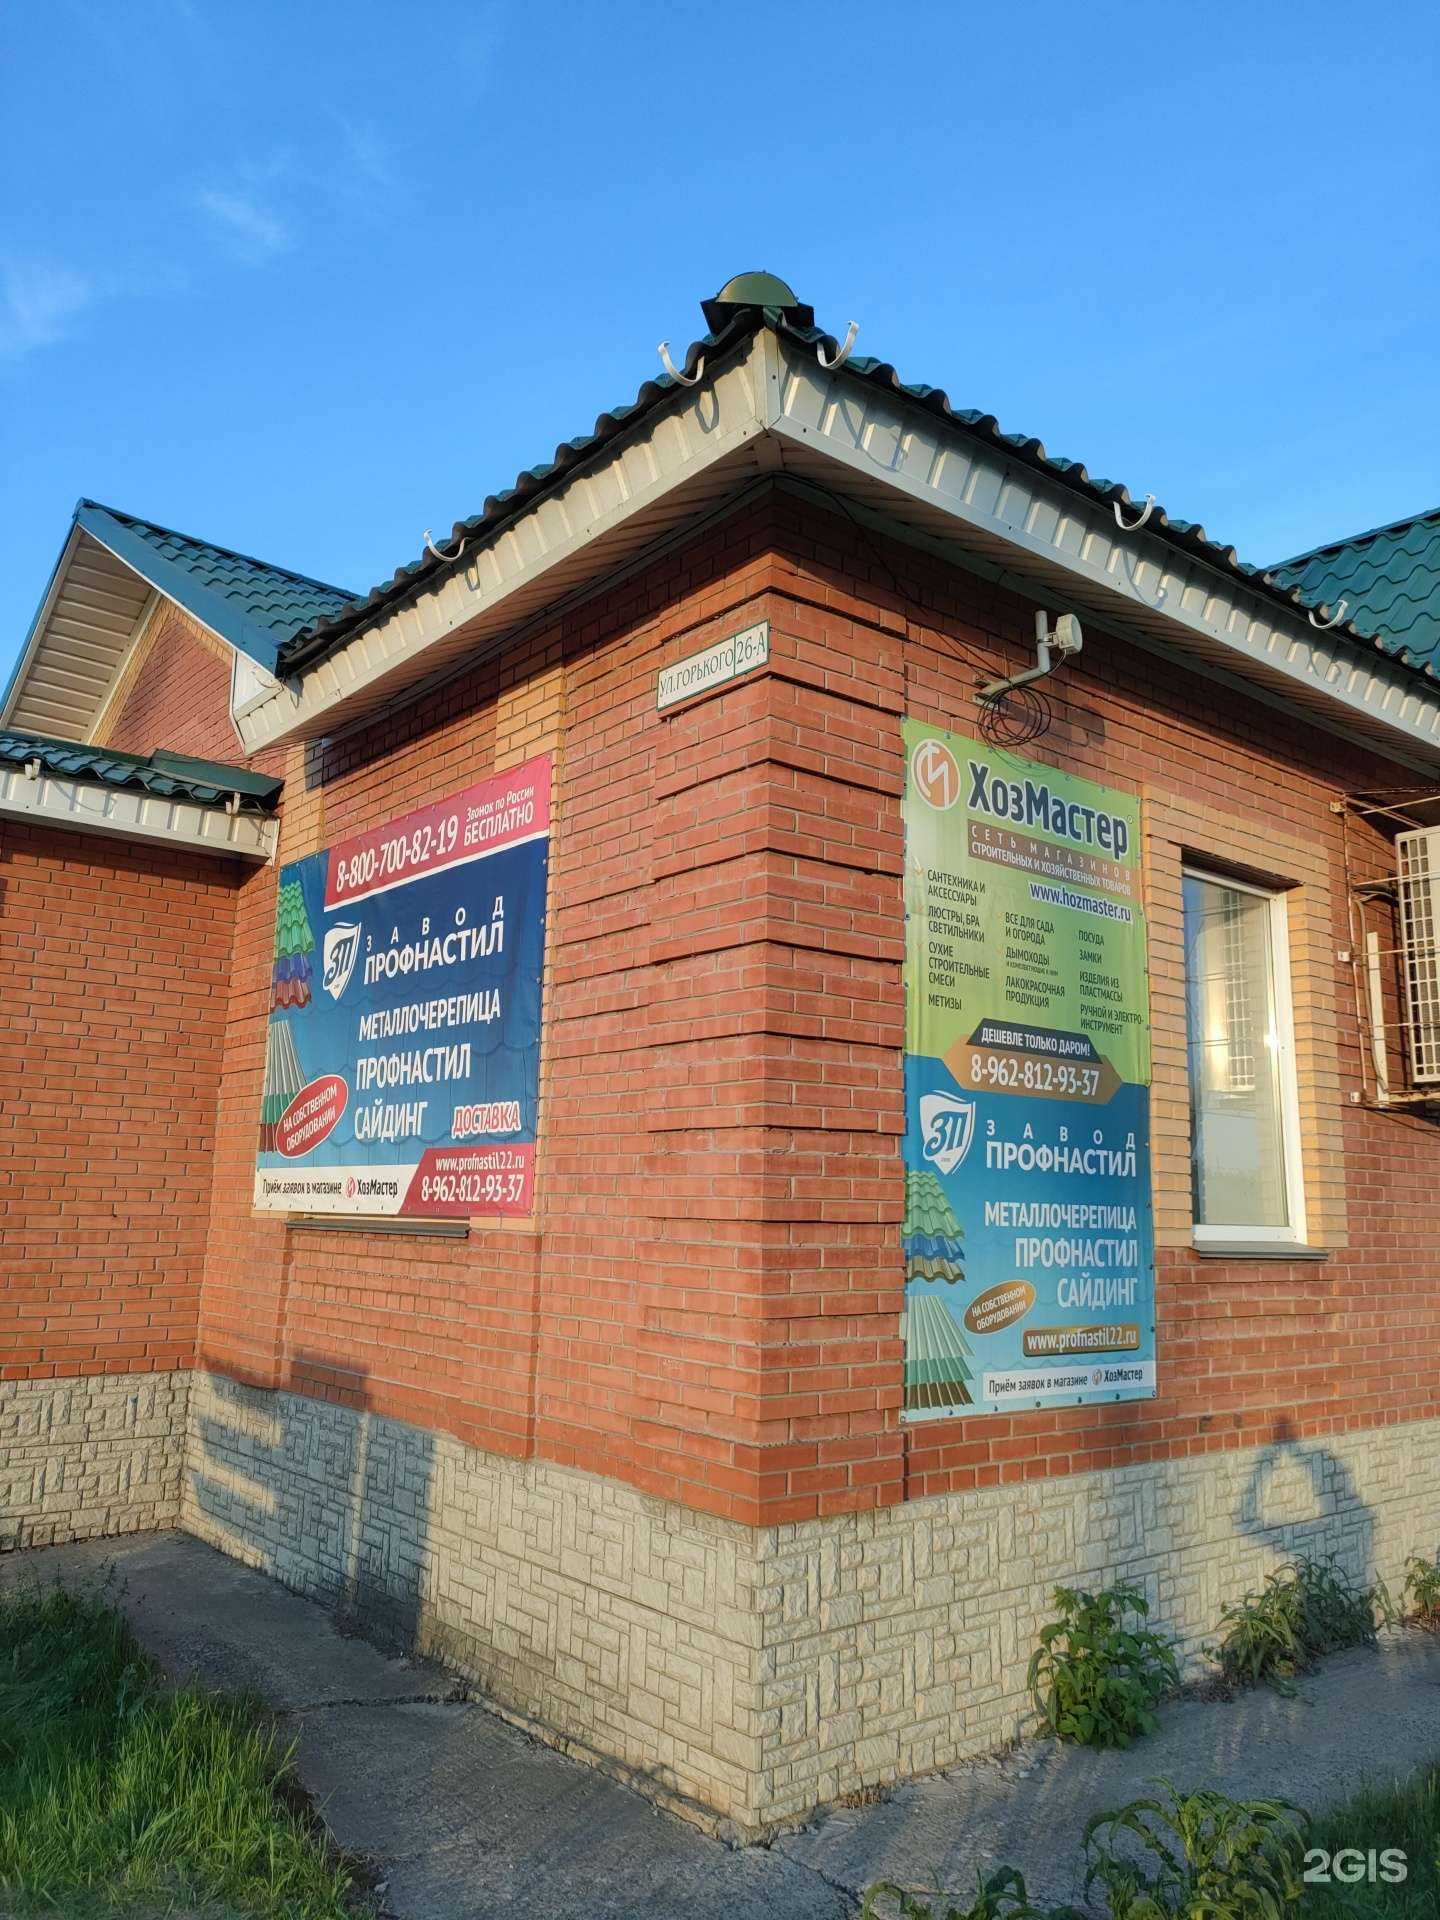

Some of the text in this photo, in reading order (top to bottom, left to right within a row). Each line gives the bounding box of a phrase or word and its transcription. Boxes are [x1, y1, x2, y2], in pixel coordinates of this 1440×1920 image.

[736, 631, 766, 664] 26-А
[466, 785, 535, 822] Звонок по России
[968, 761, 1128, 859] ХозМастер
[463, 801, 534, 846] БЕСПЛАТНО
[336, 815, 459, 892] 8-800-700-82-19
[971, 825, 1130, 881] СЕТЬ МАГАЗИНОВ
[927, 869, 986, 894] САНТЕХНИКА И
[971, 841, 1131, 896] СТРОИТЕЛЬНЫХ И ХОЗЯЙСТВЕННЫХ ТОВАРОВ
[927, 885, 977, 906] АКСЕССУАРЫ
[1030, 883, 1131, 921] www.hozmaster.ru
[366, 896, 504, 952] ЗАВОД
[928, 905, 980, 928] ЛЮСТРЫ, БРА
[928, 920, 985, 943] СВЕТИЛЬНИКИ
[1005, 911, 1055, 934] ВСЕ ДЛЯ САДА
[928, 941, 954, 958] СУХИЕ
[1005, 926, 1046, 945] И ОГОРОДА
[1079, 929, 1105, 946] ПОСУДА
[364, 921, 504, 985] ПРОФНАСТИЛ
[928, 957, 990, 979] СТРОИТЕЛЬНЫЕ
[1005, 946, 1050, 967] ДЫМОХОДЫ
[1080, 949, 1102, 964] ЗАМКИ
[928, 971, 955, 987] СМЕСИ
[1005, 975, 1066, 997] ЛАКОКРАСОЧНАЯ
[1080, 970, 1120, 989] ИЗДЕЛИЯ ИЗ
[1080, 984, 1123, 1002] ПЛАСТМАССЫ
[928, 993, 962, 1010] МЕТИЗЫ
[1005, 990, 1049, 1009] ПРОДУКЦИЯ
[1080, 1003, 1144, 1025] РУЧНОЙ И ЭЛЕКТРО-
[358, 988, 501, 1042] МЕТАЛЛОЧЕРЕПИЦА
[1080, 1017, 1123, 1035] ИНСТРУМЕНТ
[981, 1027, 1090, 1057] ДЕШЕВЛЕ ТОЛЬКО ДАРОМ!
[356, 1043, 471, 1090] ПРОФНАСТИЛ
[970, 1054, 1099, 1096] 8-962-812-93-37
[283, 1083, 337, 1133] НА СОБСТВЕННОМ
[354, 1099, 428, 1143] САЙДИНГ
[452, 1101, 521, 1138] ДОСТАВКА
[286, 1105, 336, 1151] ОБОРУДОВАНИИ
[986, 1119, 1136, 1150] ЗАВОД
[435, 1151, 525, 1174] www.profnastil22.ru
[986, 1141, 1137, 1177] ПРОФНАСТИЛ
[262, 1178, 398, 1198] Приём заявок в магазине ХозМастер
[421, 1174, 525, 1202] 8-962-812-93-37
[984, 1201, 1137, 1233] МЕТАЛЛОЧЕРЕПИЦА
[1015, 1237, 1138, 1268] ПРОФНАСТИЛ
[971, 1285, 1026, 1318] НА СОБСТВЕННОМ
[1056, 1272, 1138, 1311] САЙДИНГ
[976, 1300, 1027, 1330] ОБОРУДОВАНИИ
[1027, 1326, 1137, 1352] www.profnastil22.ru
[989, 1368, 1143, 1396] Приём заявок в магазине ХозМастер
